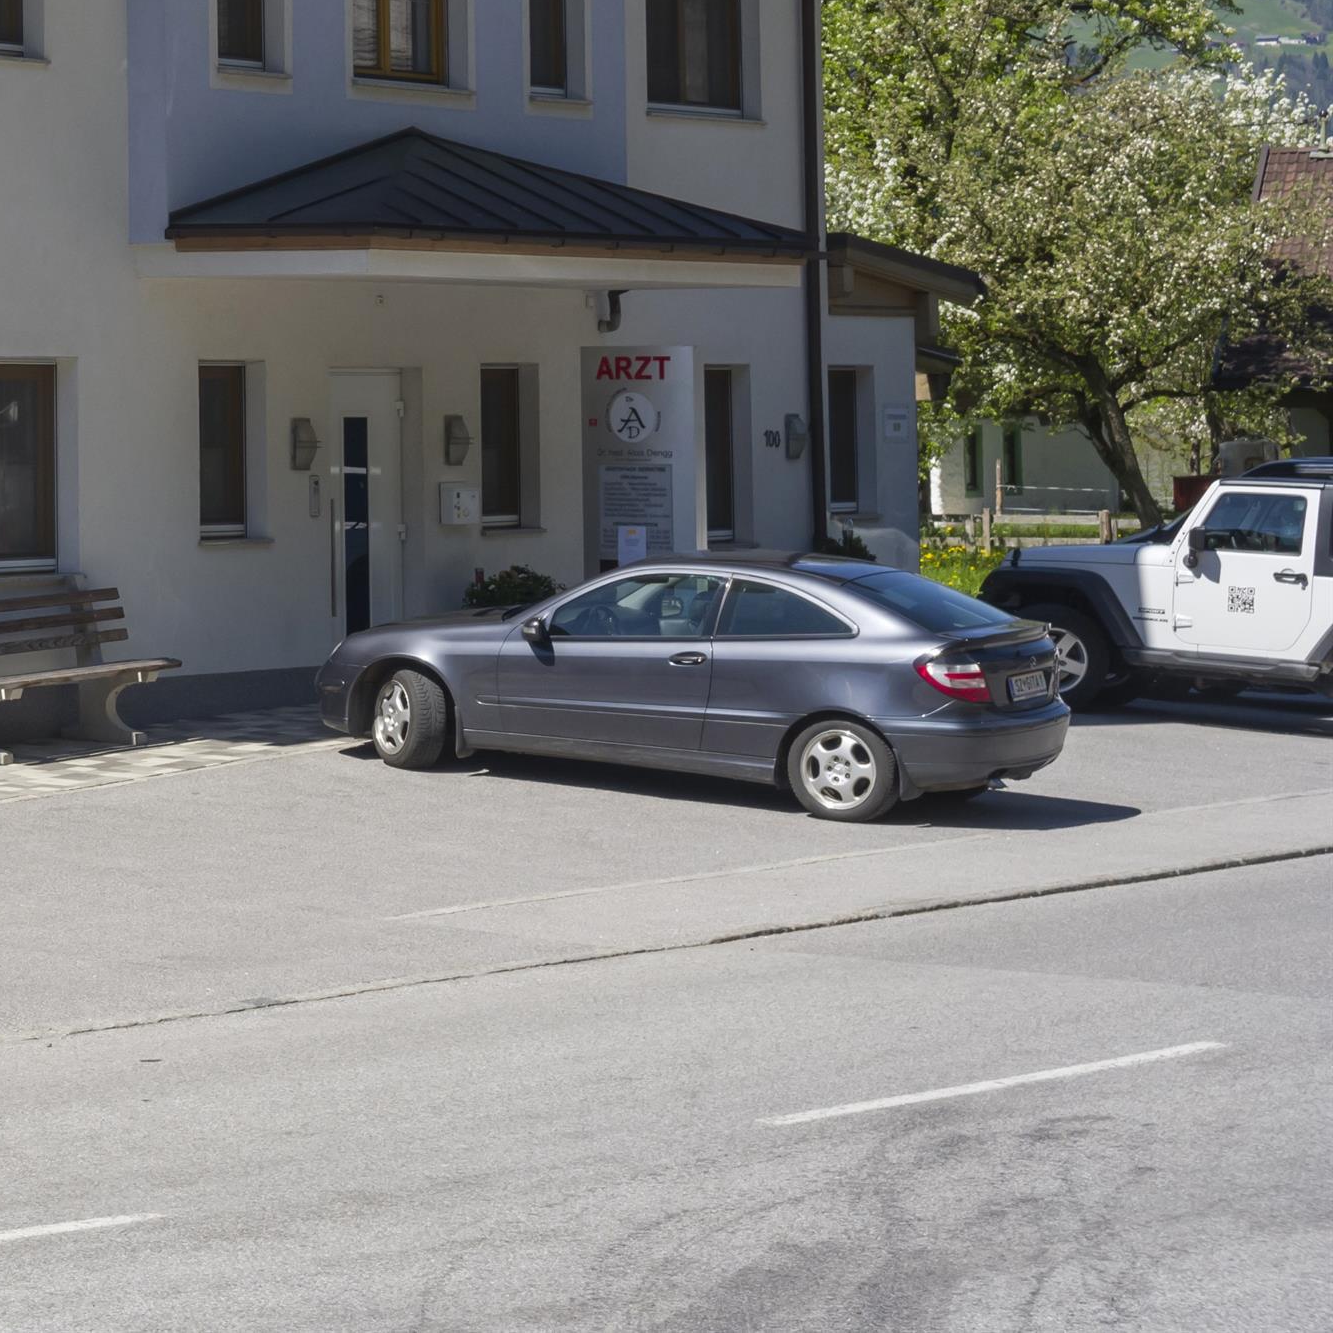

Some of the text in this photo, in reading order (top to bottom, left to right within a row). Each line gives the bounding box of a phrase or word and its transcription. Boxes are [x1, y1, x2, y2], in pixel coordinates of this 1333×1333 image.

[596, 356, 671, 380] ARZT
[763, 430, 781, 448] 100
[646, 448, 673, 459] Dengg
